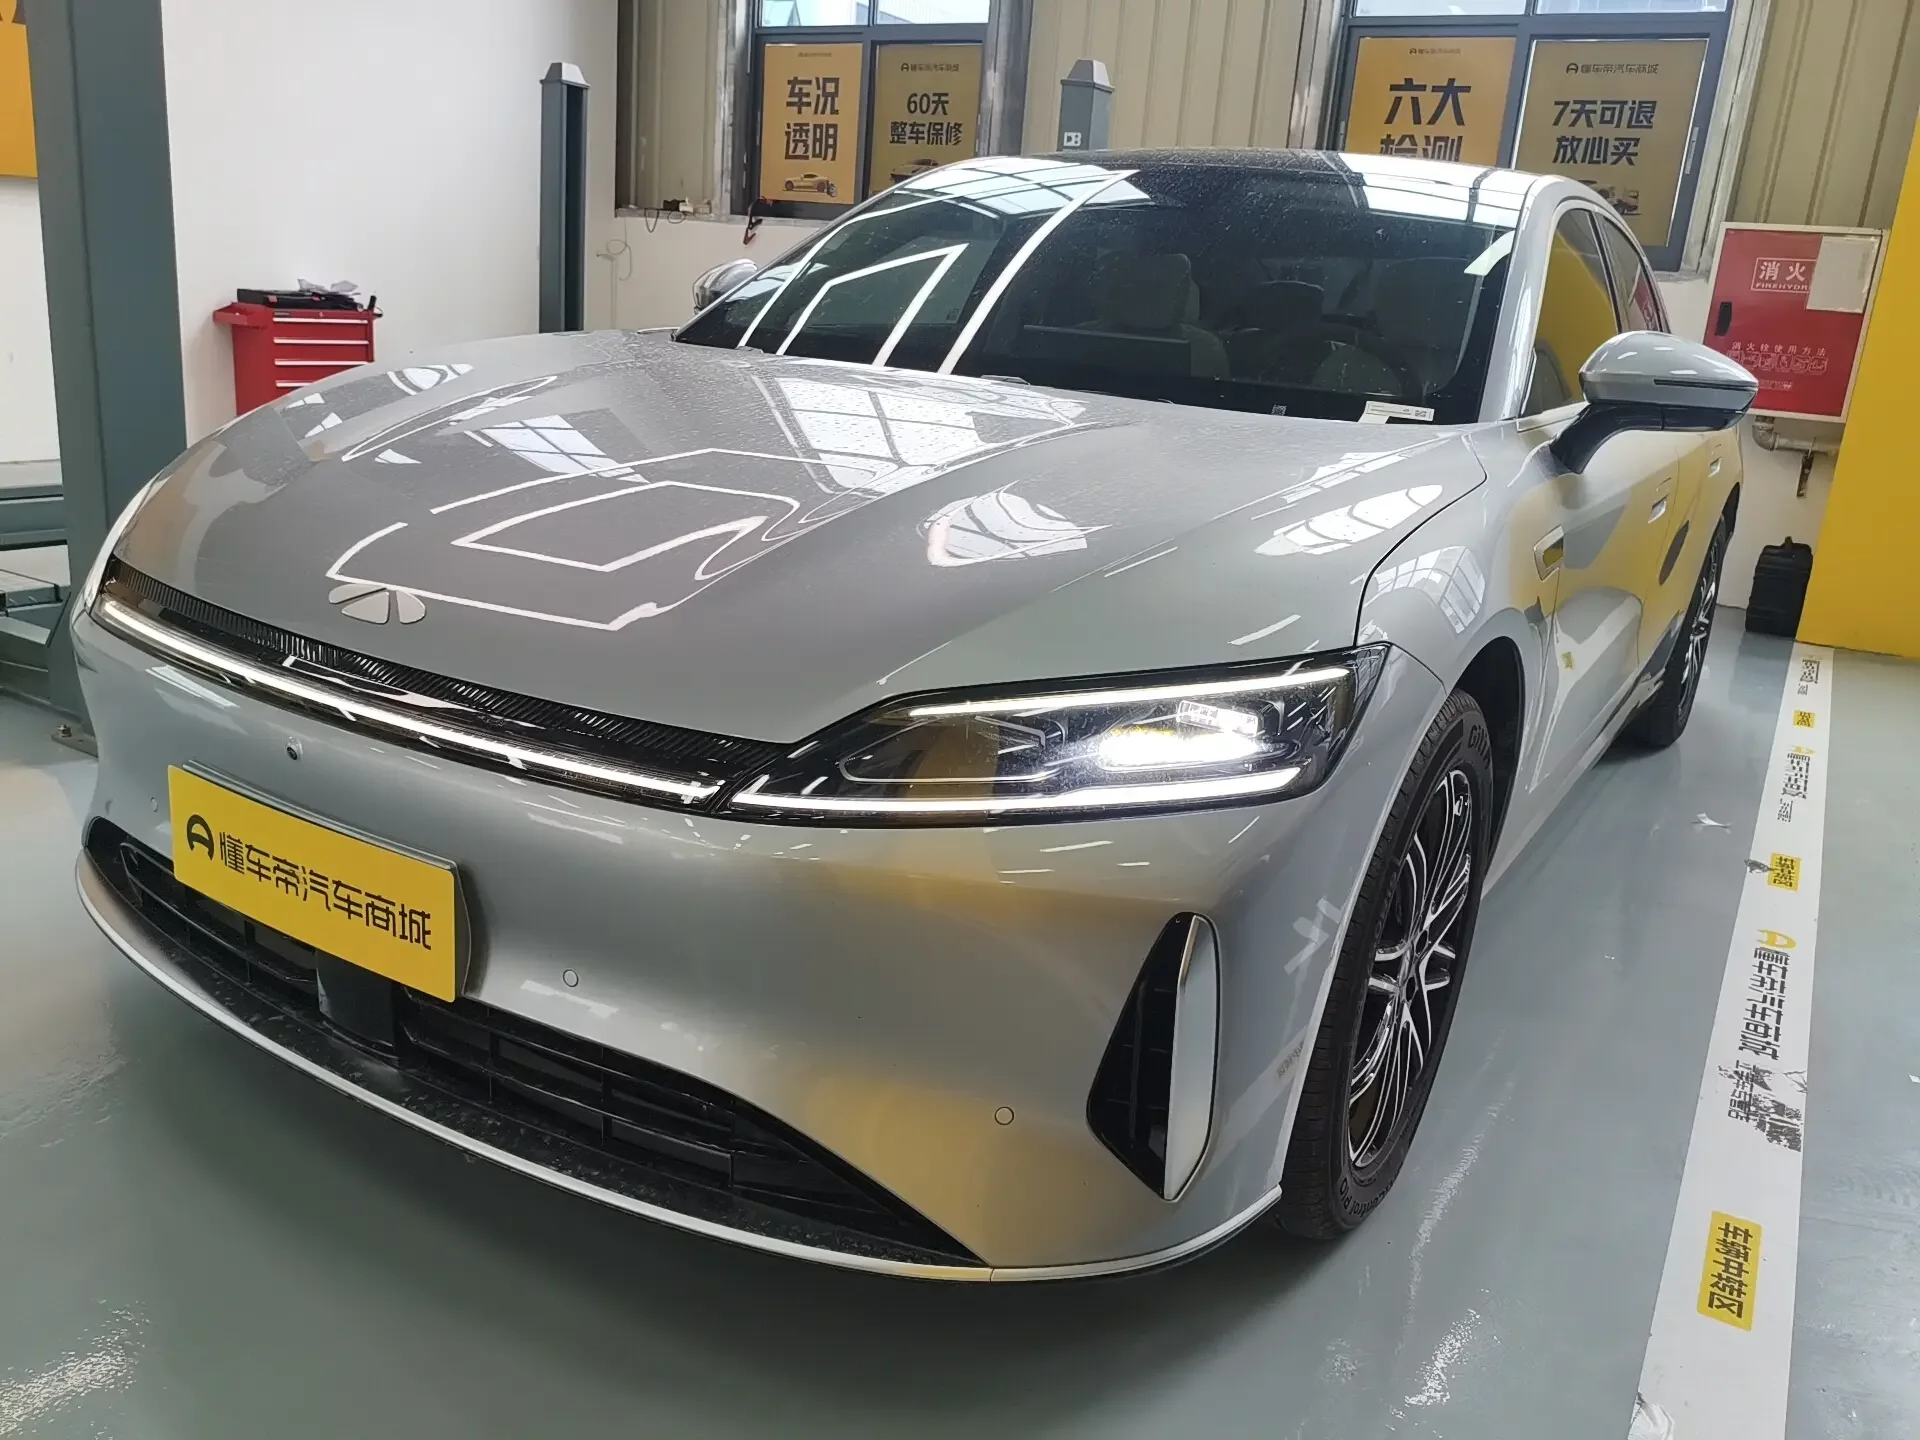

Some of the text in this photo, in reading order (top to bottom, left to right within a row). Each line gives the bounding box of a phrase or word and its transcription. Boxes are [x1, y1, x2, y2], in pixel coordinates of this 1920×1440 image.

[787, 77, 840, 115] 车况
[906, 92, 949, 116] 60天
[1384, 78, 1472, 127] 六大
[1551, 100, 1658, 129] 7天可退
[785, 122, 838, 161] 透明
[889, 121, 963, 146] 整车保修
[1552, 136, 1641, 166] 放心买
[1755, 282, 1809, 291] FIREHYDR
[1759, 261, 1806, 281] 消火
[219, 831, 431, 950] 懂车帝汽车商城
[1738, 946, 1790, 1060] 懂车帝汽车商城
[1708, 1222, 1753, 1318] 车辆中转区
